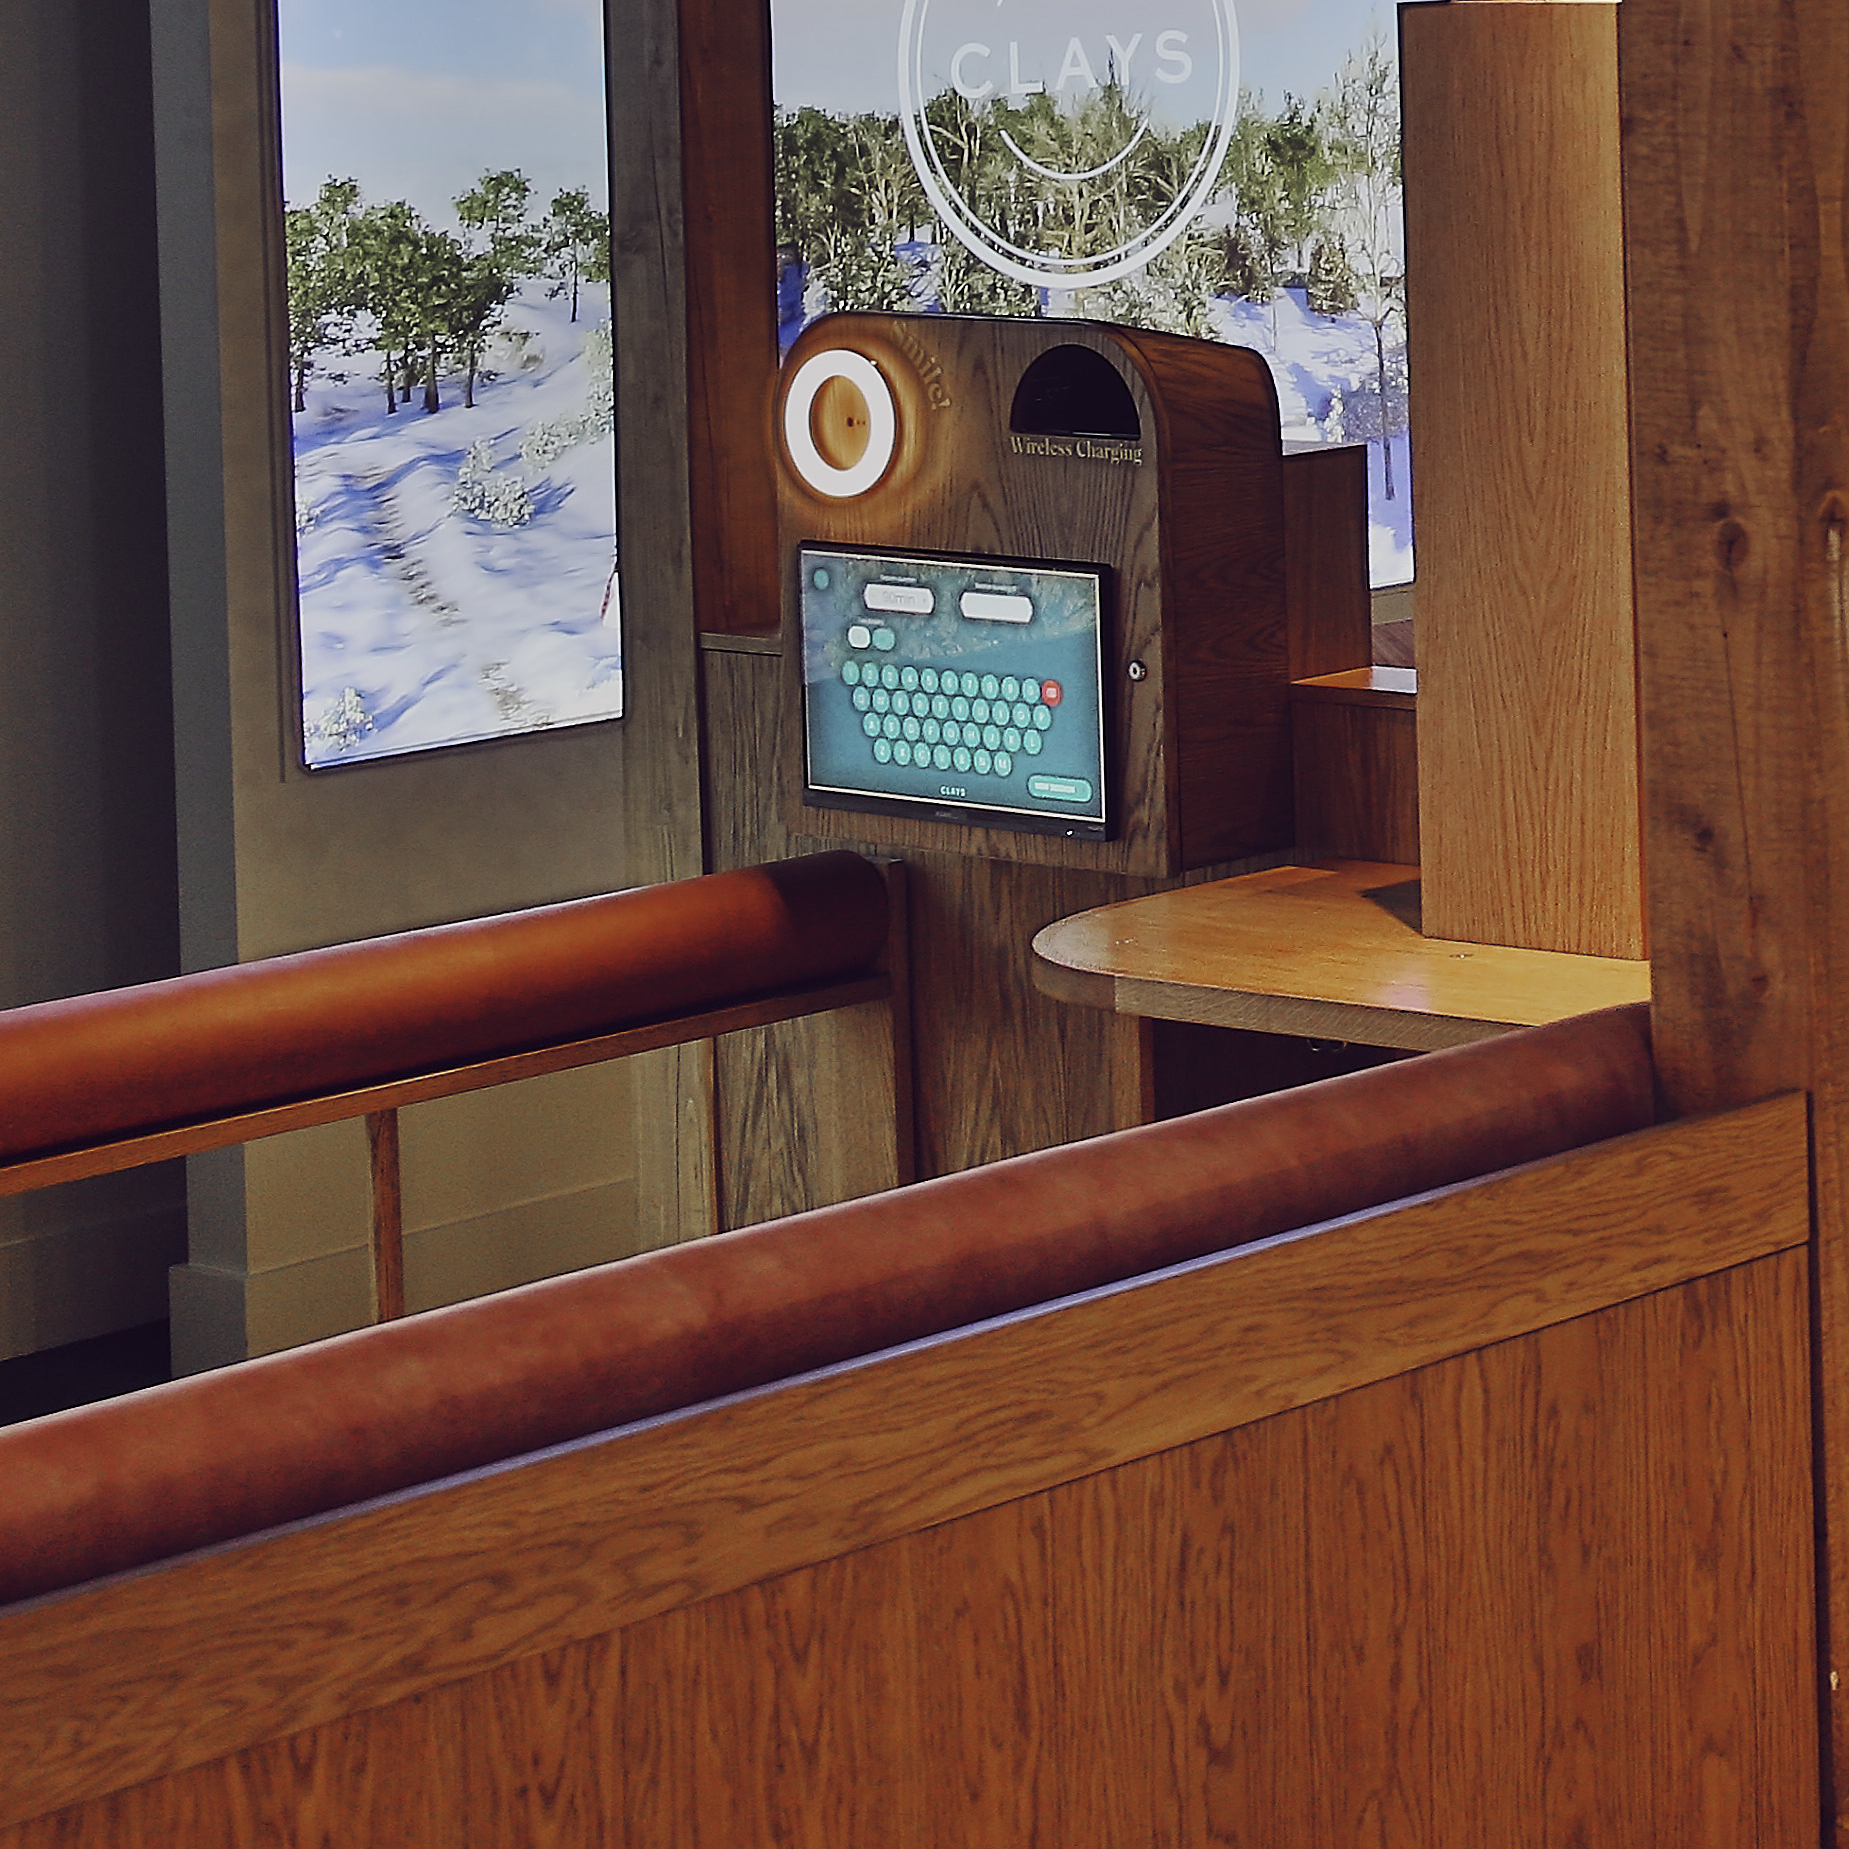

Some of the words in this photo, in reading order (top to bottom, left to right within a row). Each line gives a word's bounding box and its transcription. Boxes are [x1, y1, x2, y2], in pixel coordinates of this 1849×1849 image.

[949, 29, 1193, 100] CLAYS
[1010, 436, 1072, 457] Wireless
[1076, 439, 1142, 464] Charging
[940, 785, 966, 797] CLAYS
